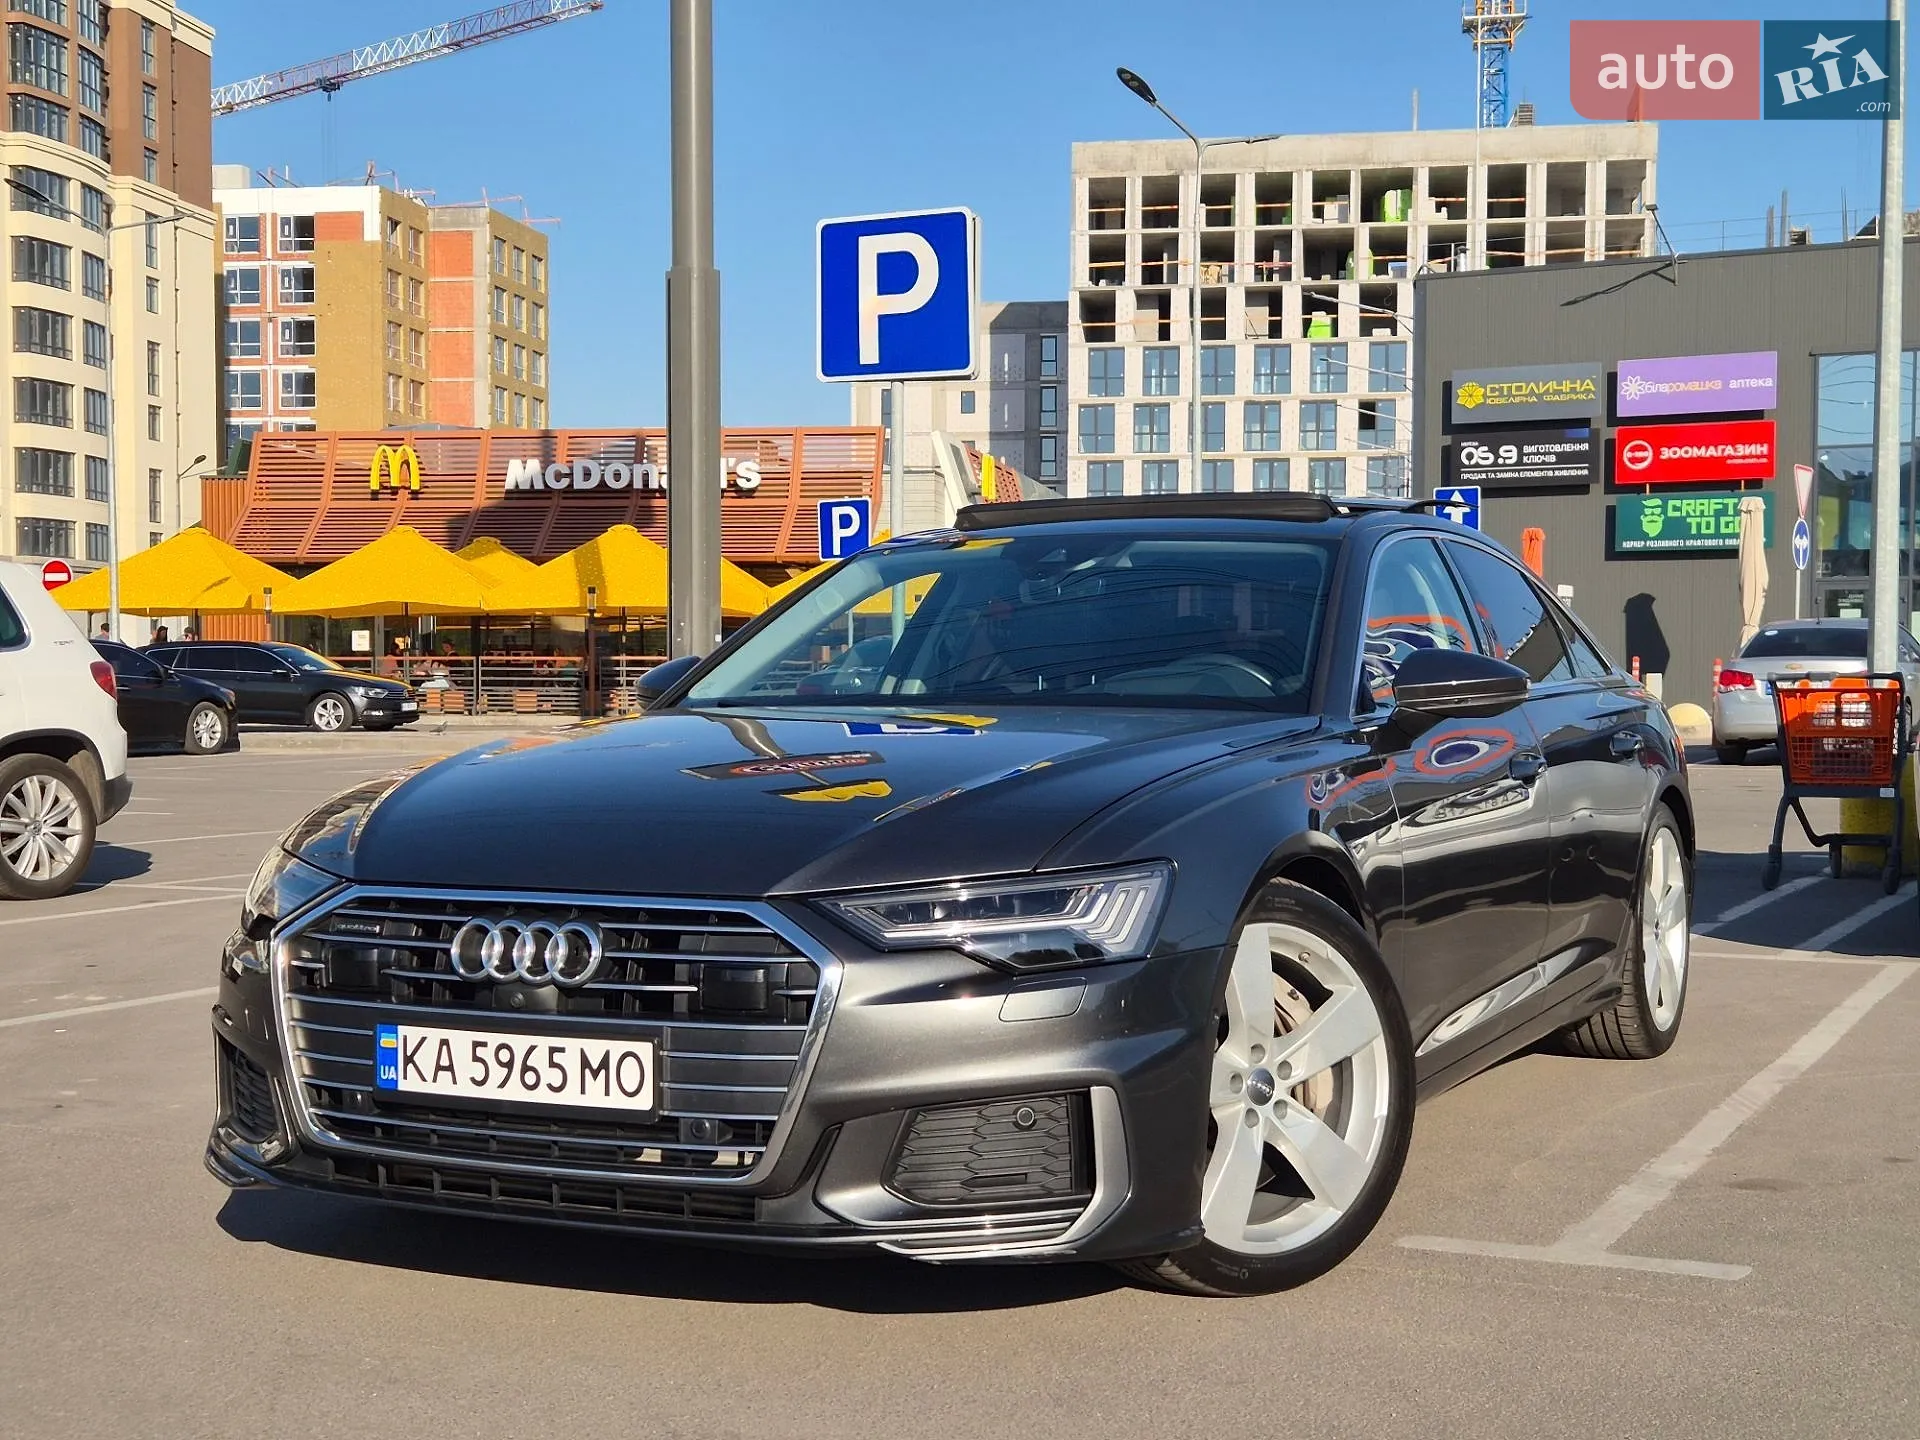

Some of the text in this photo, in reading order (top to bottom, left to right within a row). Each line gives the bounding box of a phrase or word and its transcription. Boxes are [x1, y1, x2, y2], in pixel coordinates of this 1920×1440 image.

[858, 232, 939, 365] P
[1486, 379, 1596, 397] СТОЛИЧНА
[1644, 377, 1774, 395] біларомашка аптека
[1486, 393, 1596, 405] ЮВЕЛІРНА ФАБРИКА
[1523, 443, 1589, 453] ВИГОТОВЛЕННЯ
[1659, 443, 1769, 460] ЗООМАГАЗИН
[1523, 455, 1556, 464] КЛЮЧІВ
[504, 457, 763, 491] McDon's
[1461, 472, 1486, 480] ПРОДАЖ
[1496, 471, 1519, 479] ЗАМІНА
[1667, 498, 1738, 517] CRAFT
[832, 505, 860, 555] P
[1687, 517, 1715, 535] TO
[1685, 538, 1723, 546] КРАФТОВОГО
[380, 1065, 397, 1081] UA
[402, 1035, 646, 1098] KA 5965 MO
